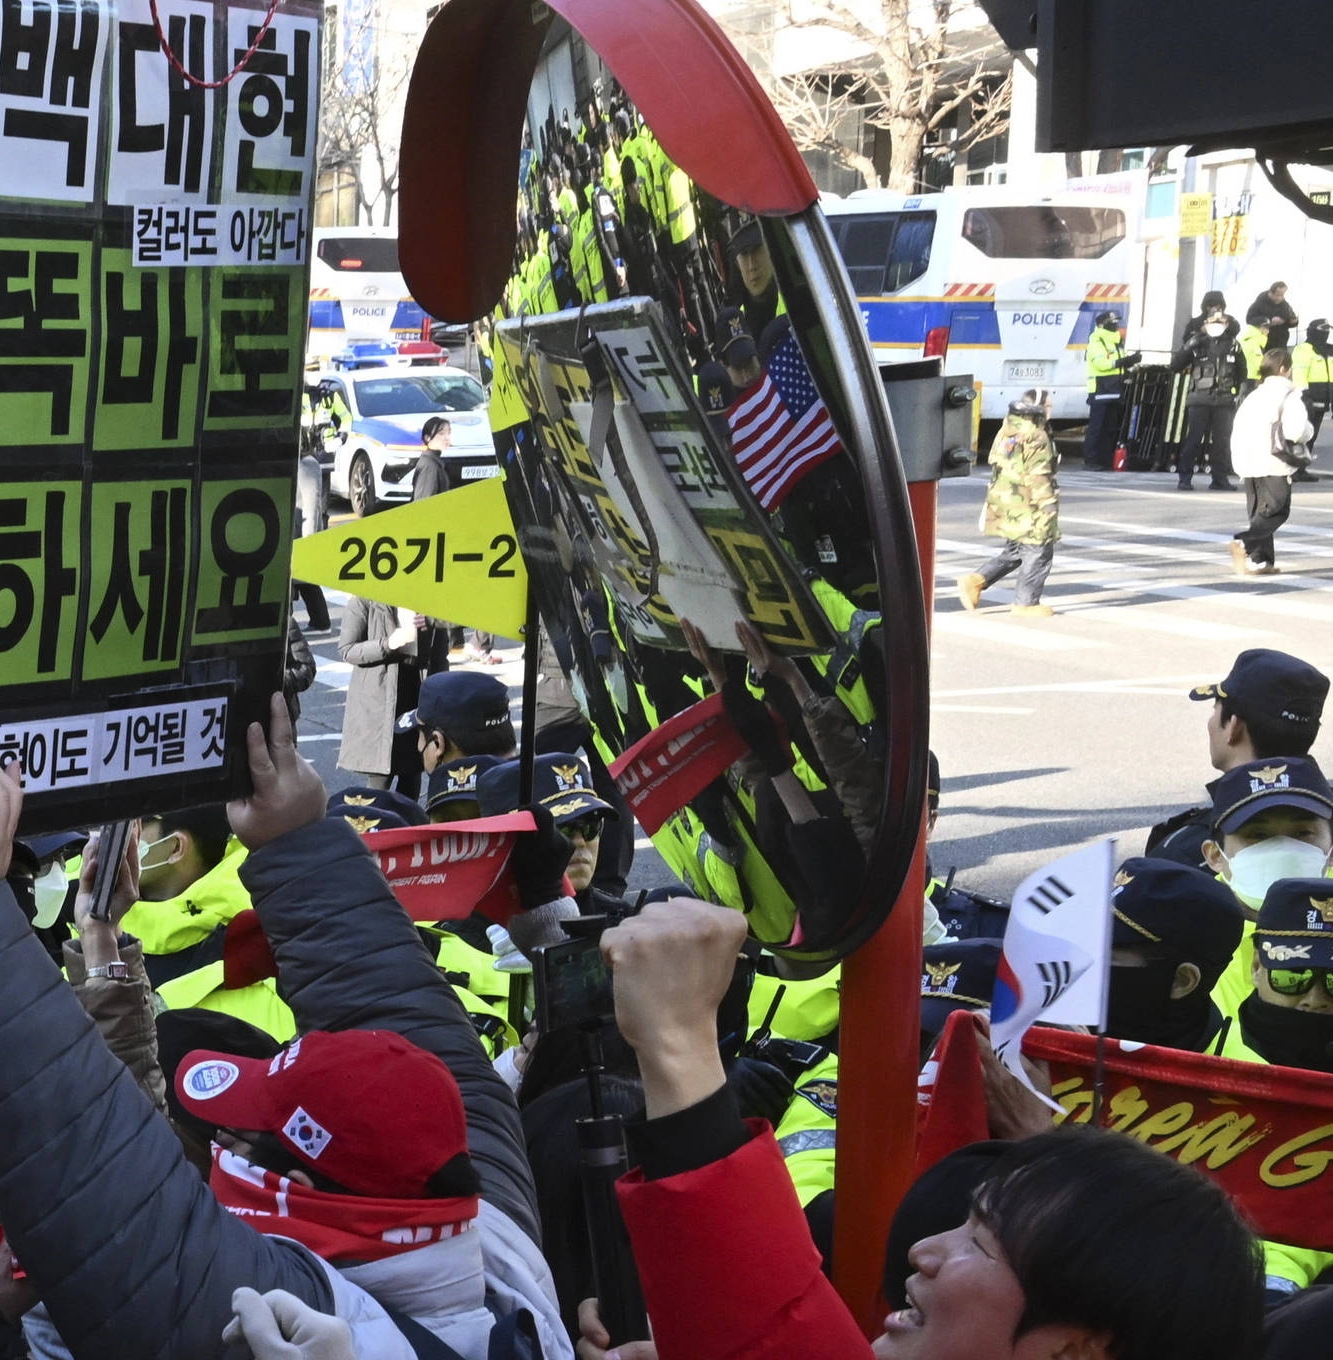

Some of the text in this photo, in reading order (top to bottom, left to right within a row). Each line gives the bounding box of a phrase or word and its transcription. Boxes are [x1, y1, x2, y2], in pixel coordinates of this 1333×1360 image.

[137, 206, 306, 262] 컬러도 아깝다
[352, 307, 386, 317] POLICE
[1011, 312, 1064, 327] POLICE
[338, 532, 516, 586] 26기-2
[102, 708, 189, 770] 기억될
[200, 701, 228, 756] 것
